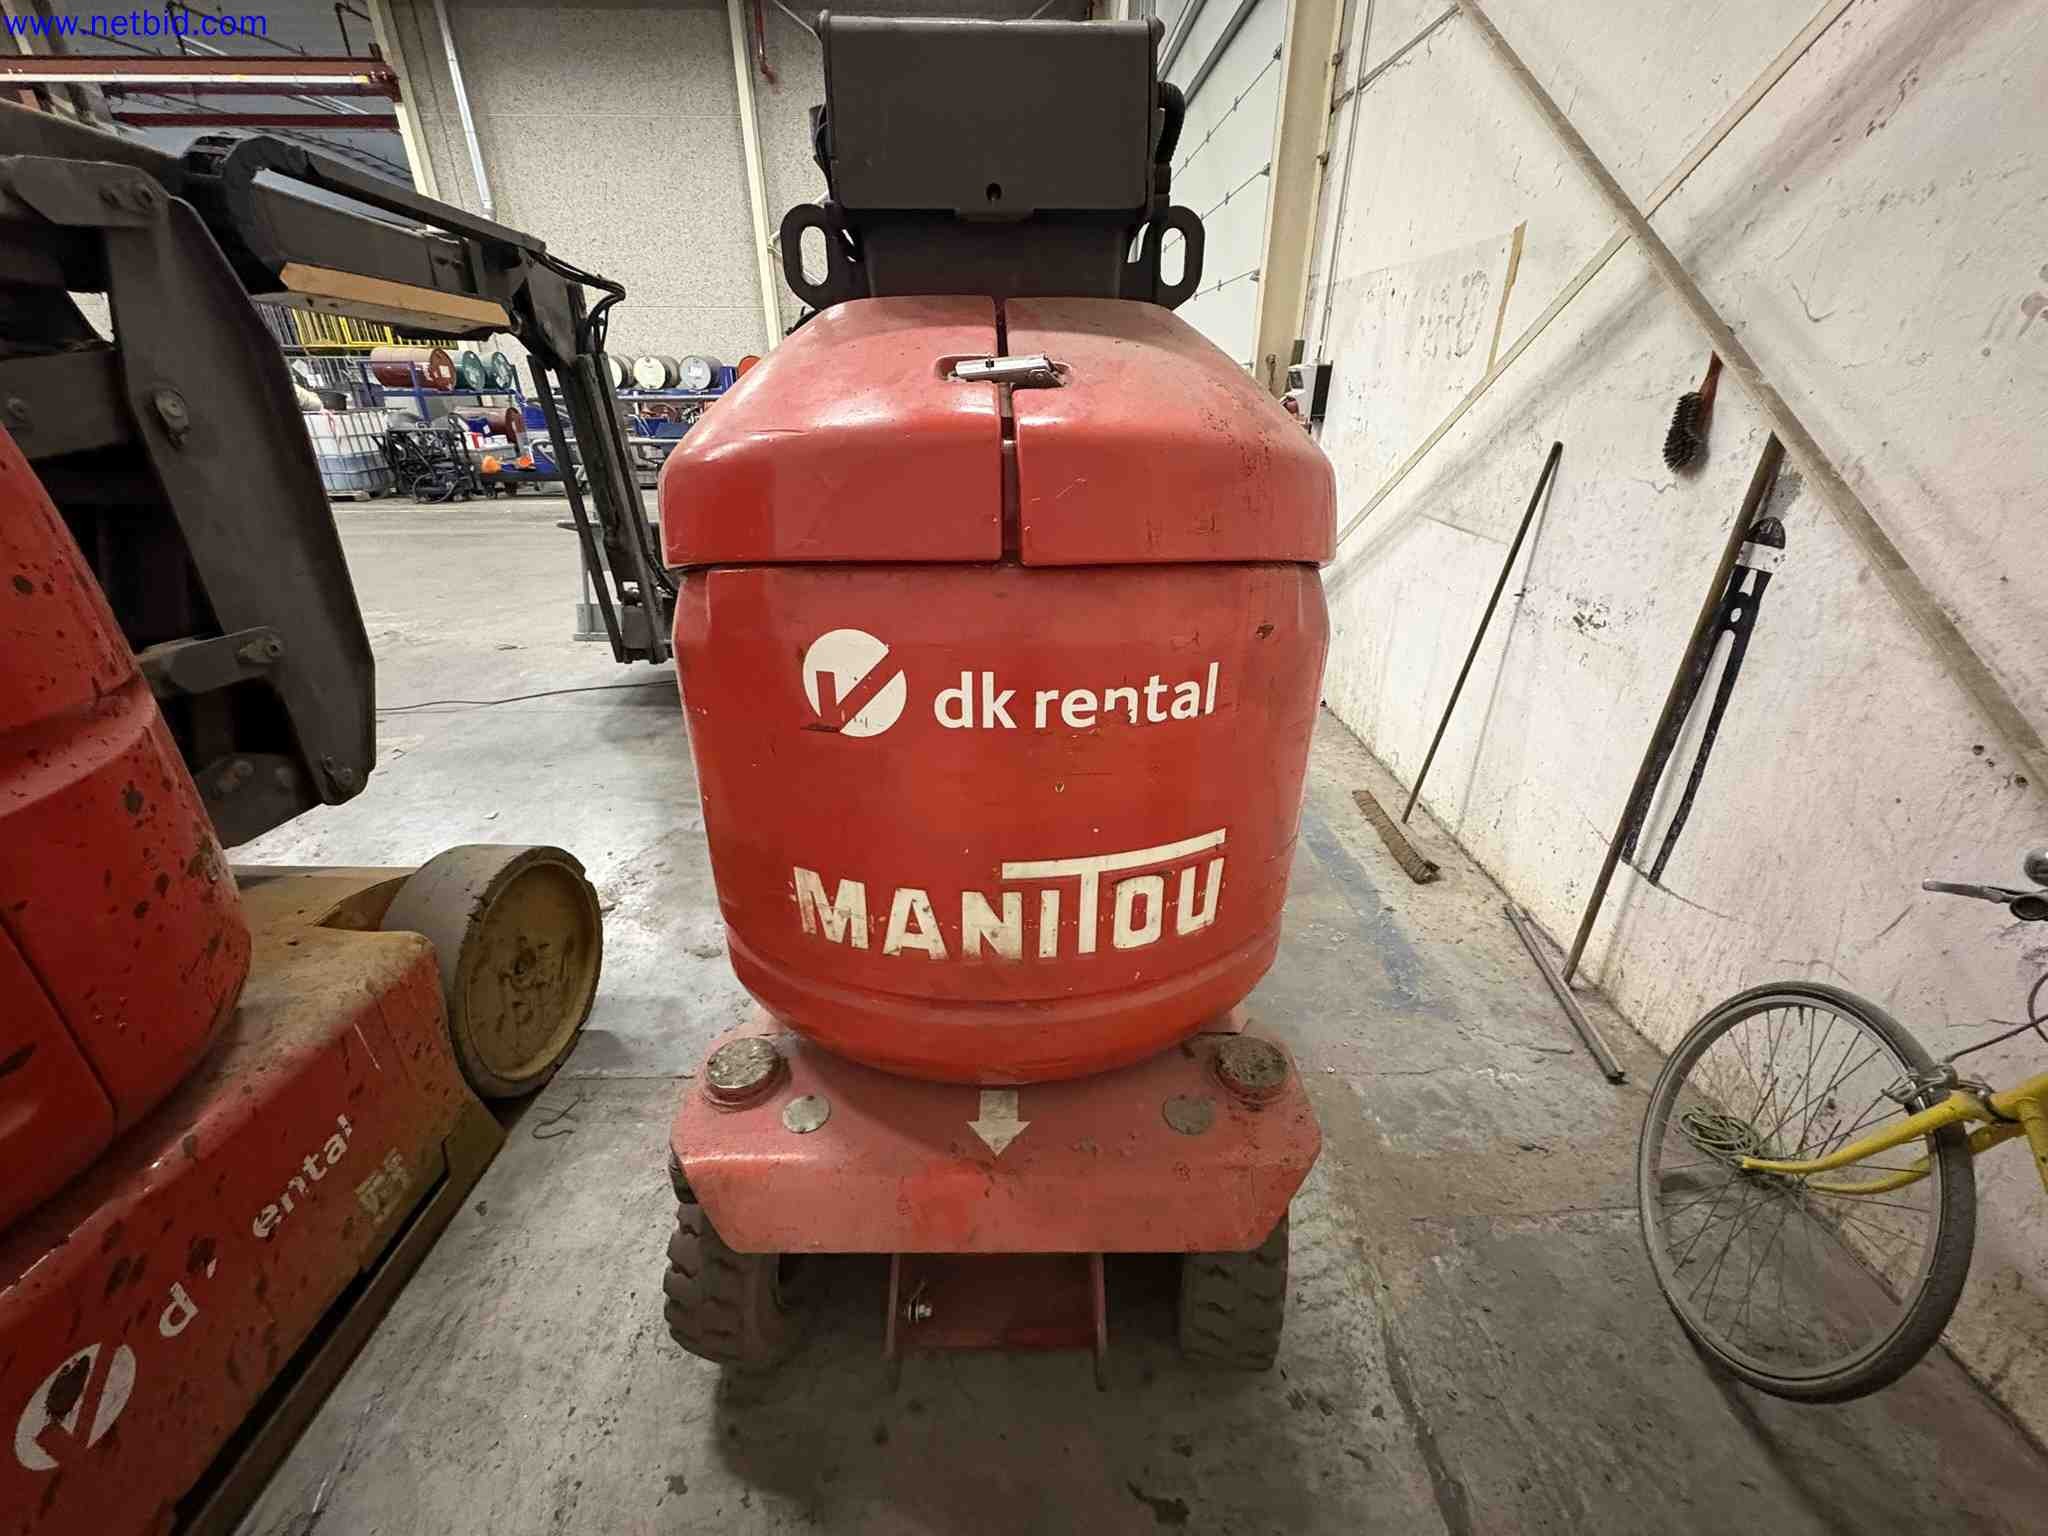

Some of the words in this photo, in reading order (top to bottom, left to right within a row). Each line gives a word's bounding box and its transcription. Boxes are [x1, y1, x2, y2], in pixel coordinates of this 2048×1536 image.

[933, 671, 1017, 729] dk
[1033, 661, 1219, 729] rental
[793, 828, 1226, 960] MANITOU
[253, 1113, 353, 1238] ental
